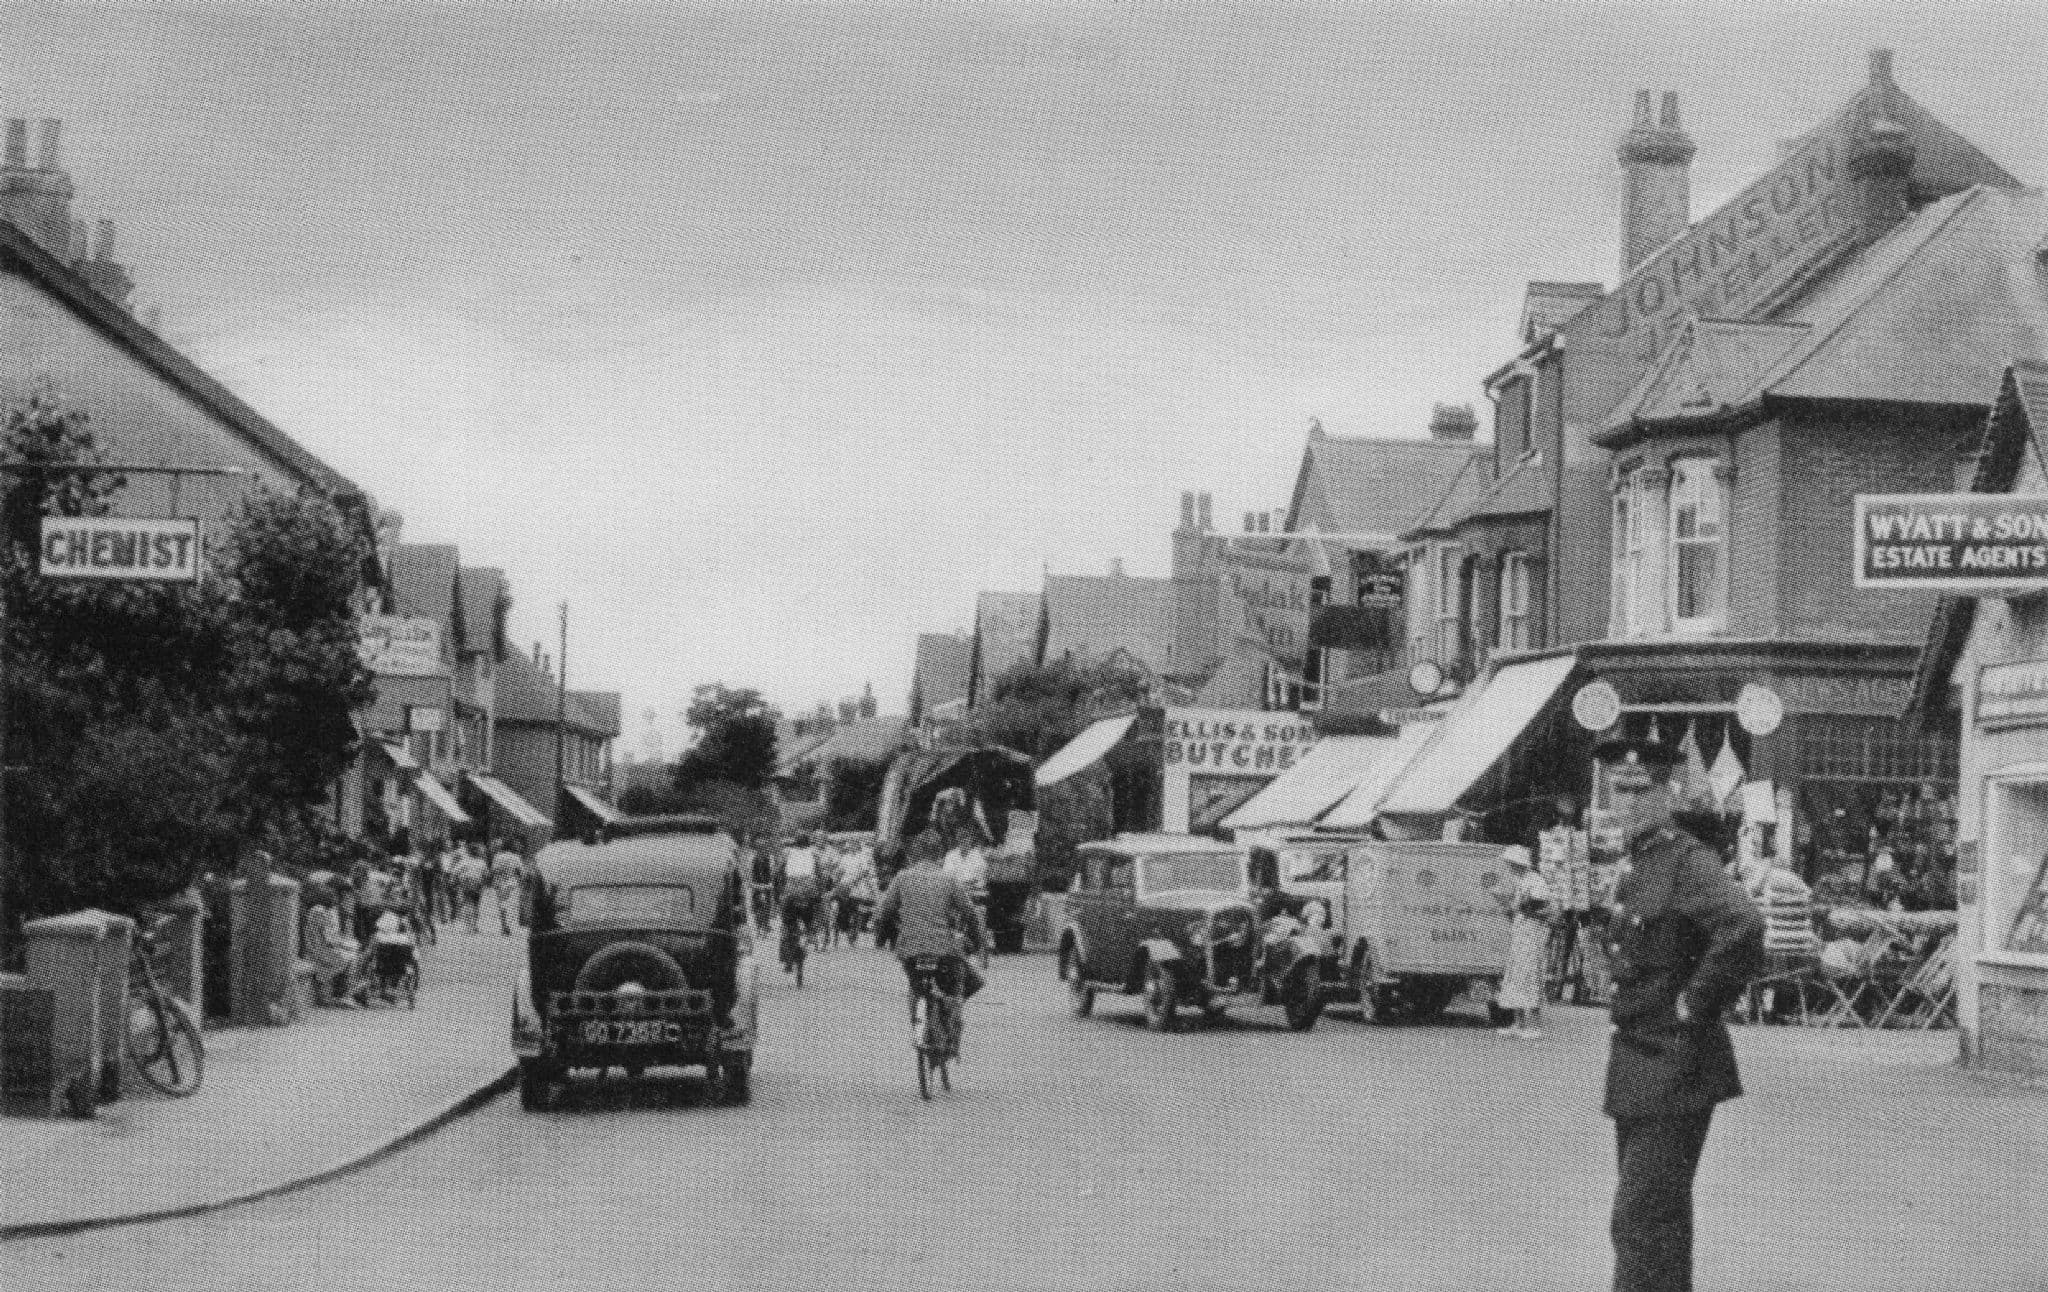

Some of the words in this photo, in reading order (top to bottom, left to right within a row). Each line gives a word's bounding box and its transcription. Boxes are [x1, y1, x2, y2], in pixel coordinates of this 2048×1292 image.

[1600, 138, 1837, 339] JOHNSON
[1870, 513, 1968, 540] WYATT
[1972, 516, 1992, 540] &
[1994, 512, 2048, 540] SON
[44, 530, 193, 568] CHEMIST
[1873, 546, 1953, 569] ESTATE
[1959, 546, 2047, 569] AGENTS
[1167, 720, 1236, 739] ELLIS
[1239, 724, 1256, 742] &
